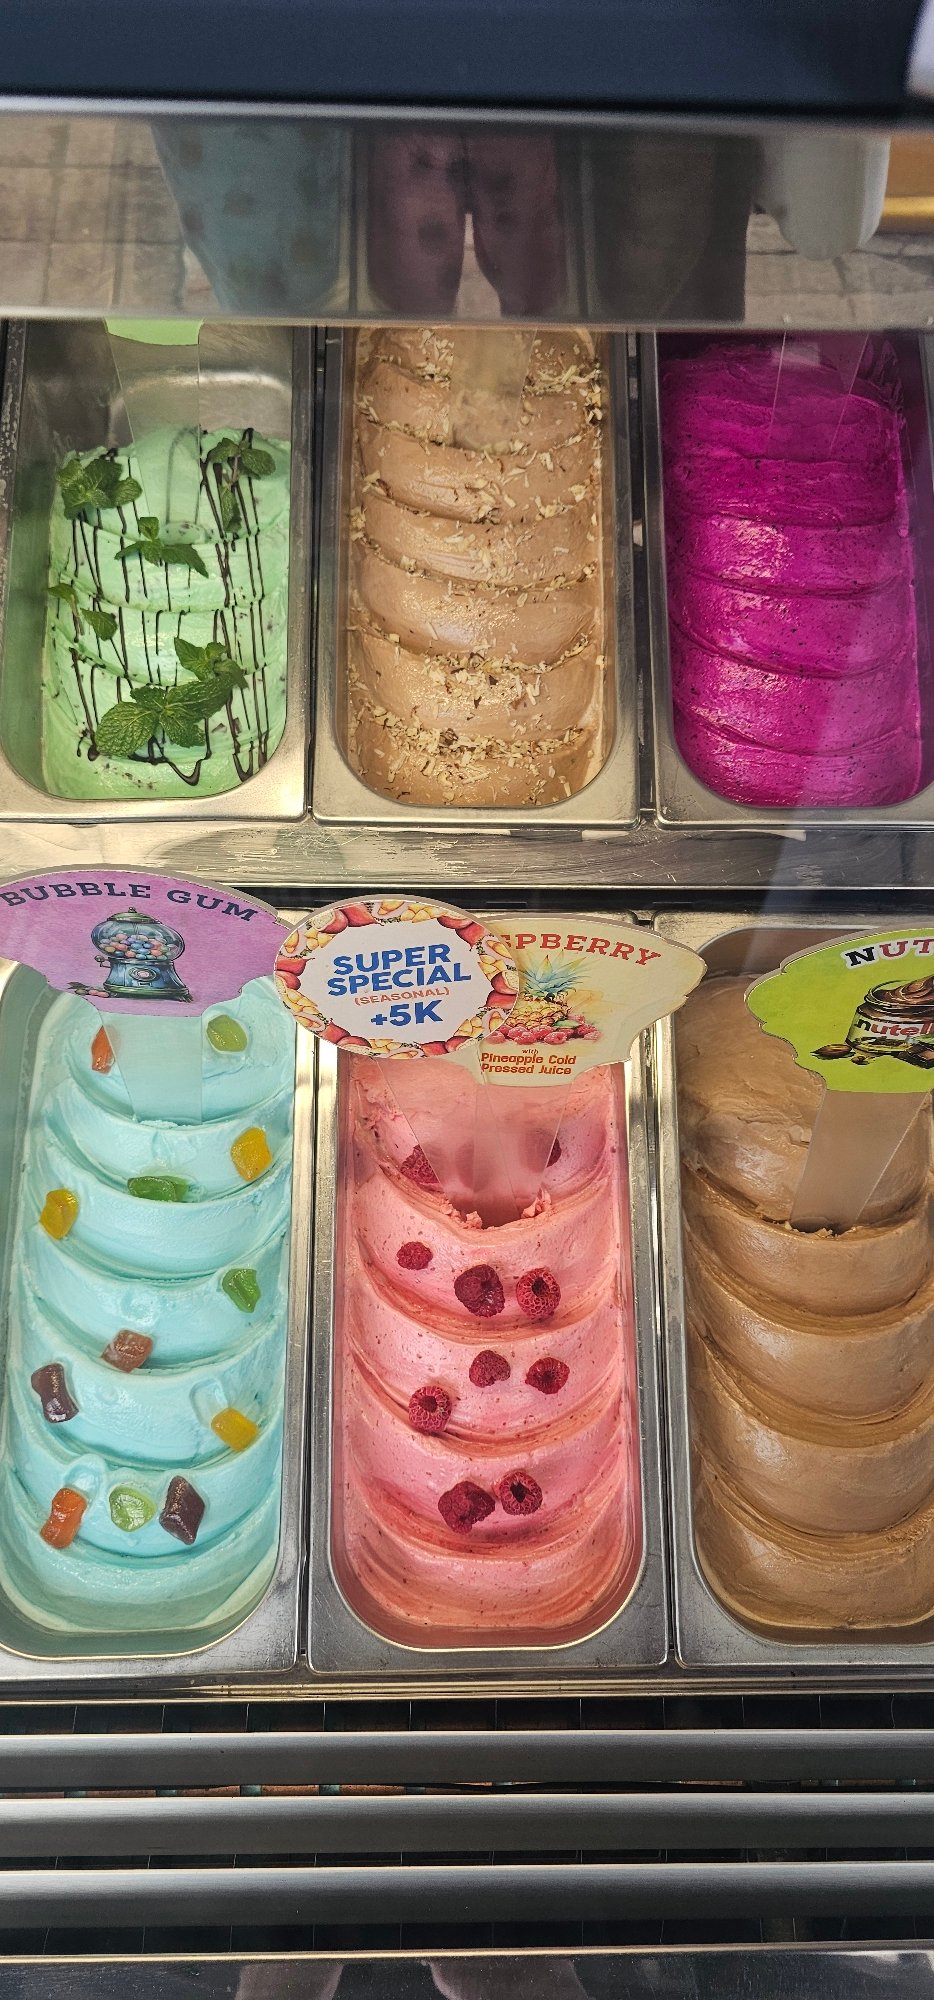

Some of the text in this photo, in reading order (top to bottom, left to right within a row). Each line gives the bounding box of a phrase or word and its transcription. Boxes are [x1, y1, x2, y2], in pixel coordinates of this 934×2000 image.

[0, 882, 258, 922] BUBBLE GUM
[333, 944, 451, 975] SUPER
[845, 938, 934, 966] NUT
[327, 962, 471, 996] SPECIAL
[354, 987, 450, 1006] (SEASONAL)
[370, 1000, 443, 1026] +5K
[481, 1052, 577, 1065] Pineapple Cold
[481, 1063, 572, 1075] Pressed Juice
